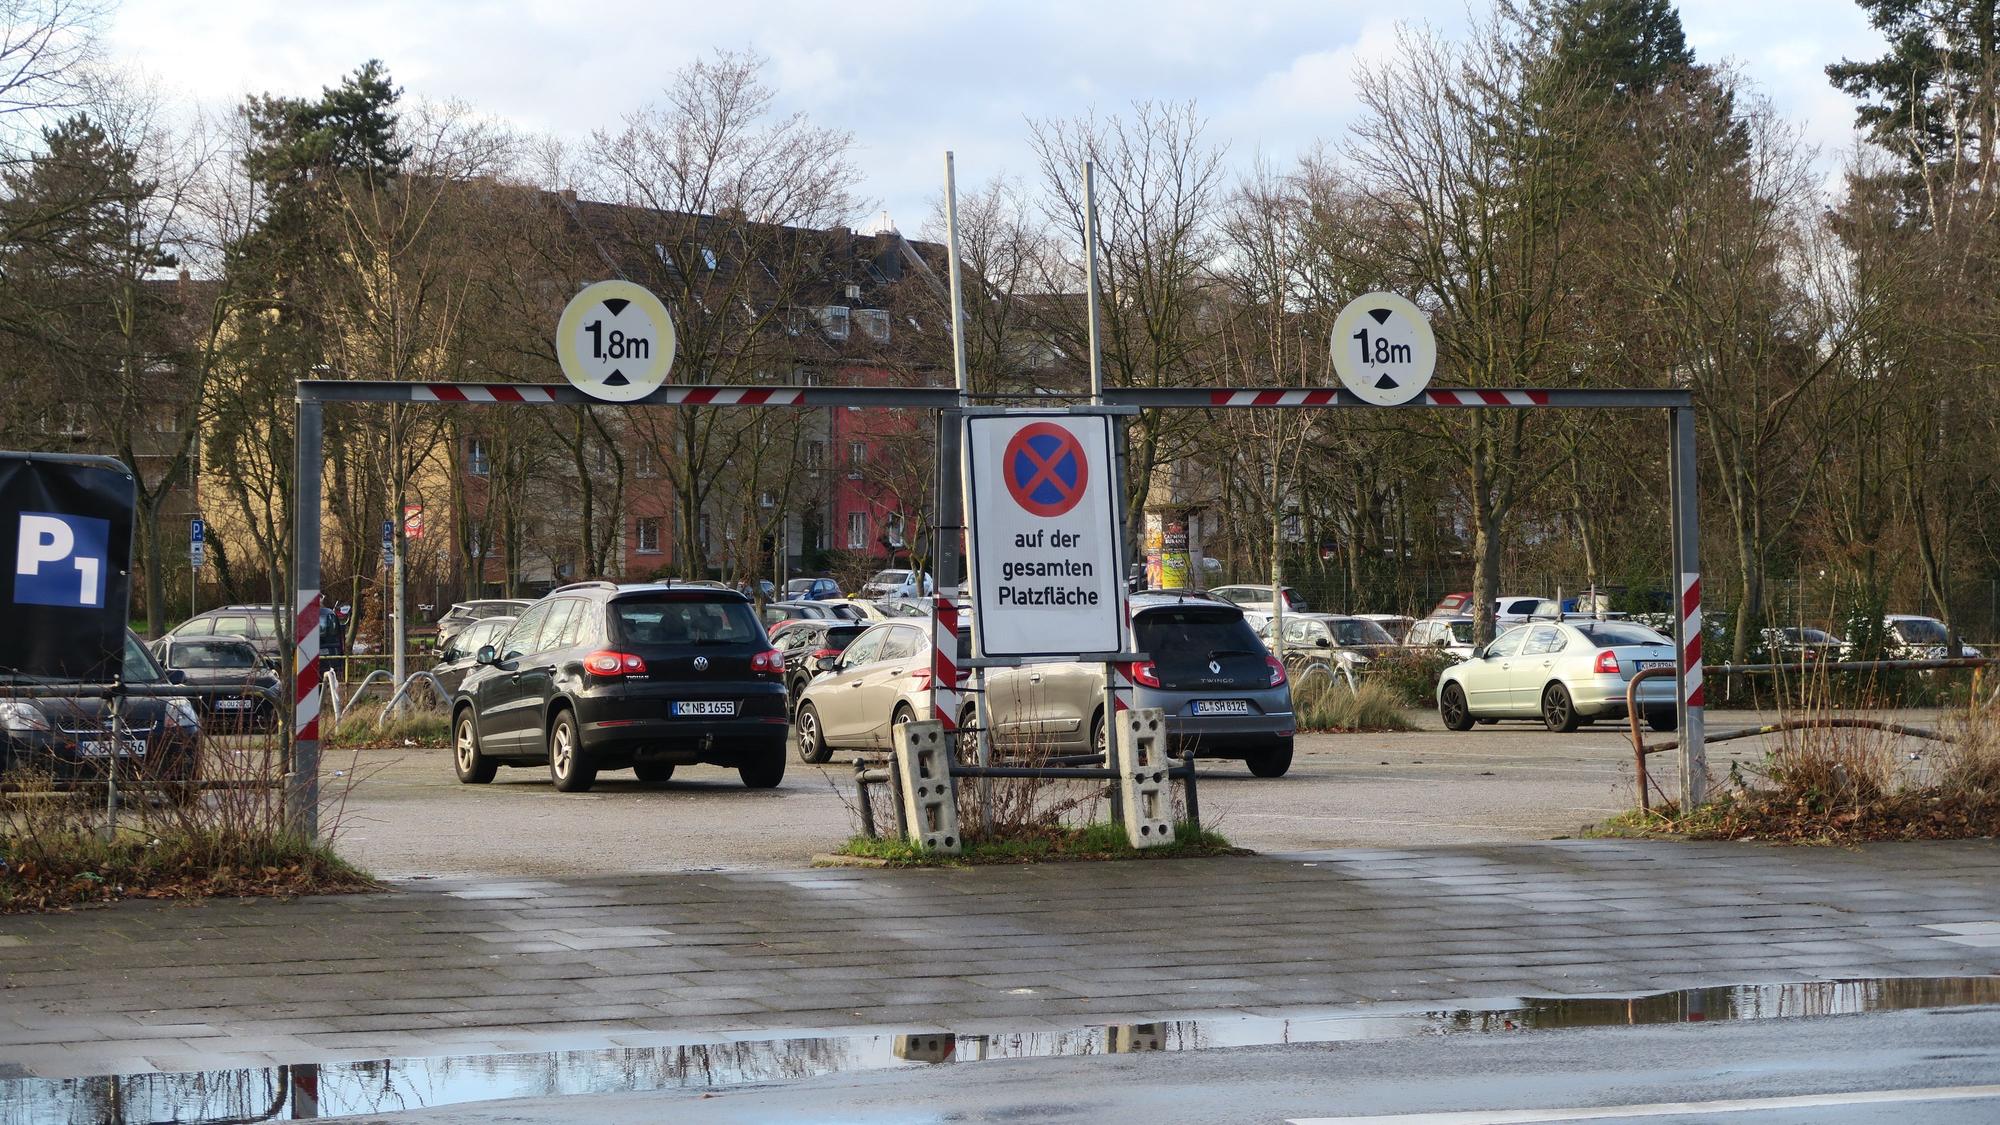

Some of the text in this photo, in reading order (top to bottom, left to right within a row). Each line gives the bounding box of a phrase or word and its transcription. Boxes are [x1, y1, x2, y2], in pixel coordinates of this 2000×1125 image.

[585, 320, 649, 364] 1,8m
[1353, 328, 1411, 368] 1,8m
[1014, 529, 1081, 548] auf der
[1002, 559, 1093, 581] gesamten
[998, 586, 1099, 605] Platzfläche
[678, 703, 733, 713] K NB 1655
[1199, 701, 1247, 712] GL SH 812E
[84, 742, 91, 753] K
